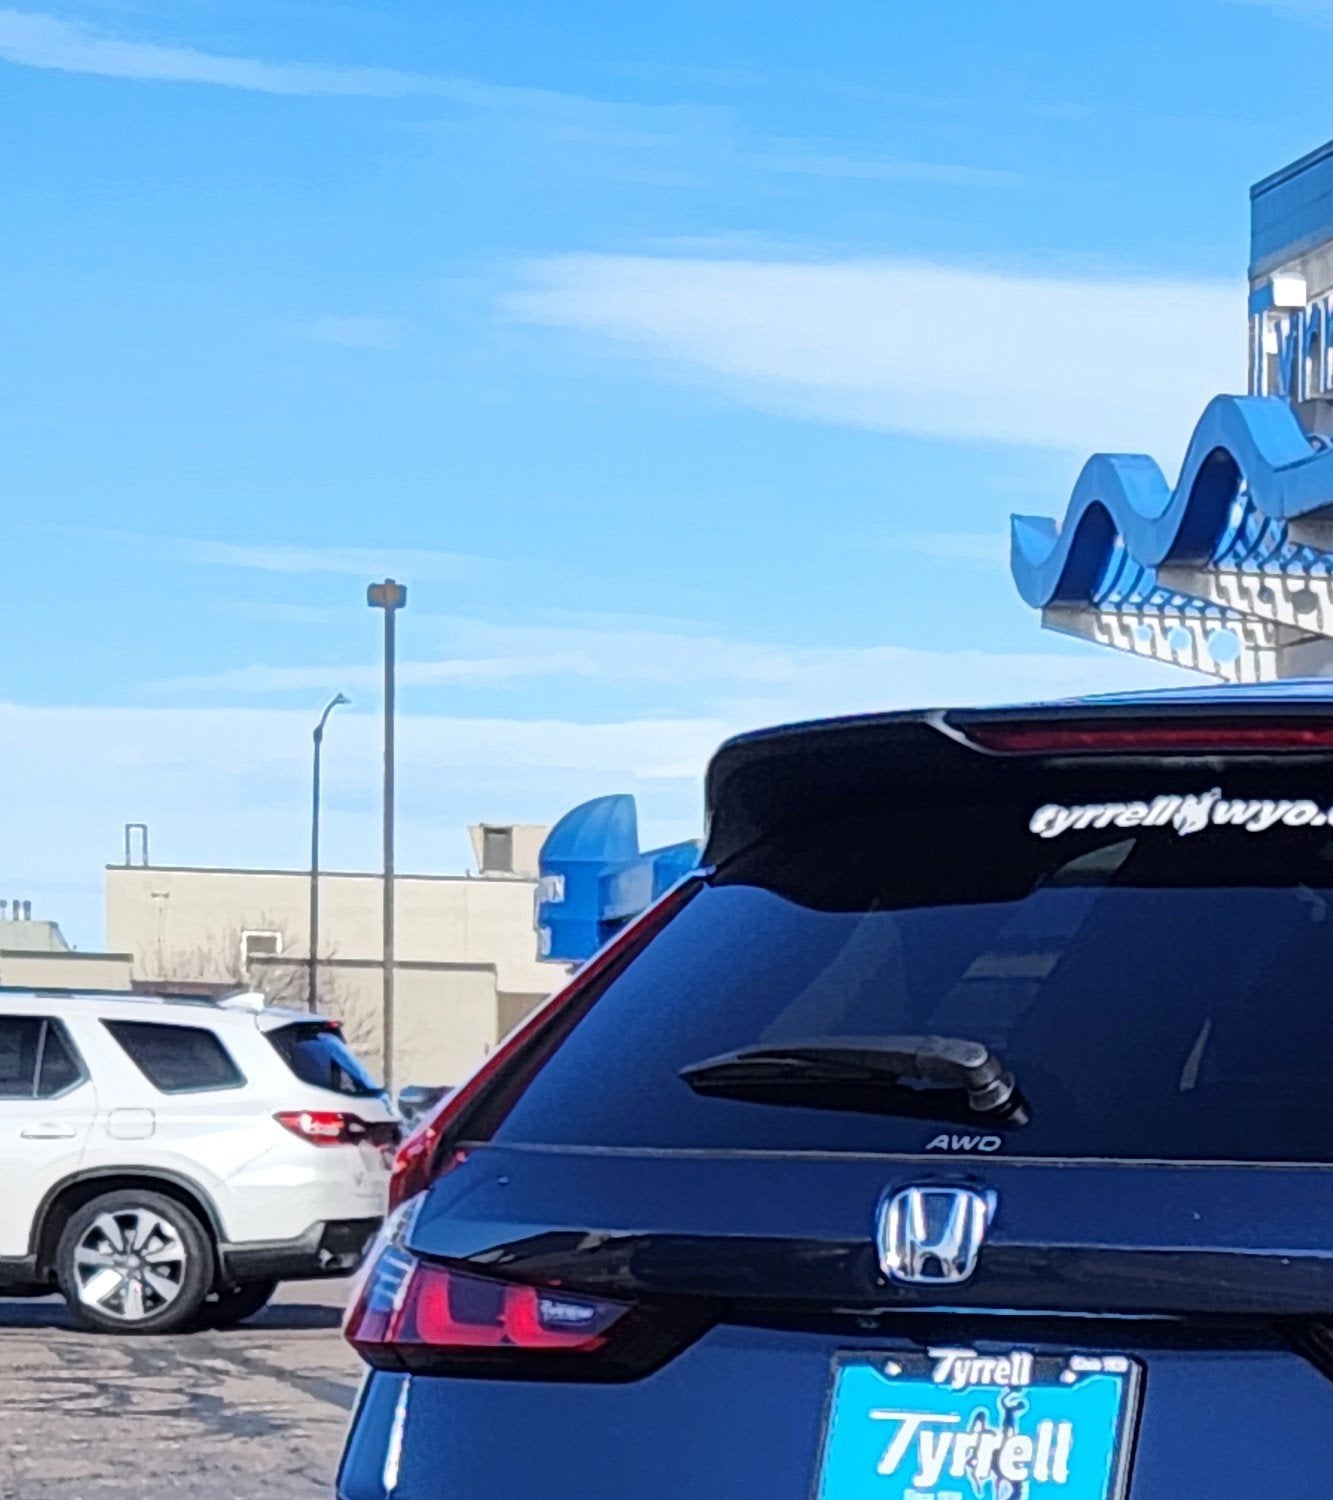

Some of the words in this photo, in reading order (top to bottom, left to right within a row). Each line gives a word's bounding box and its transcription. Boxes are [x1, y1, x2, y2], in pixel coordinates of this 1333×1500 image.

[924, 1134, 1002, 1152] AWD
[927, 1347, 1034, 1389] Tyrrell
[869, 1408, 1074, 1487] Tyrrell
